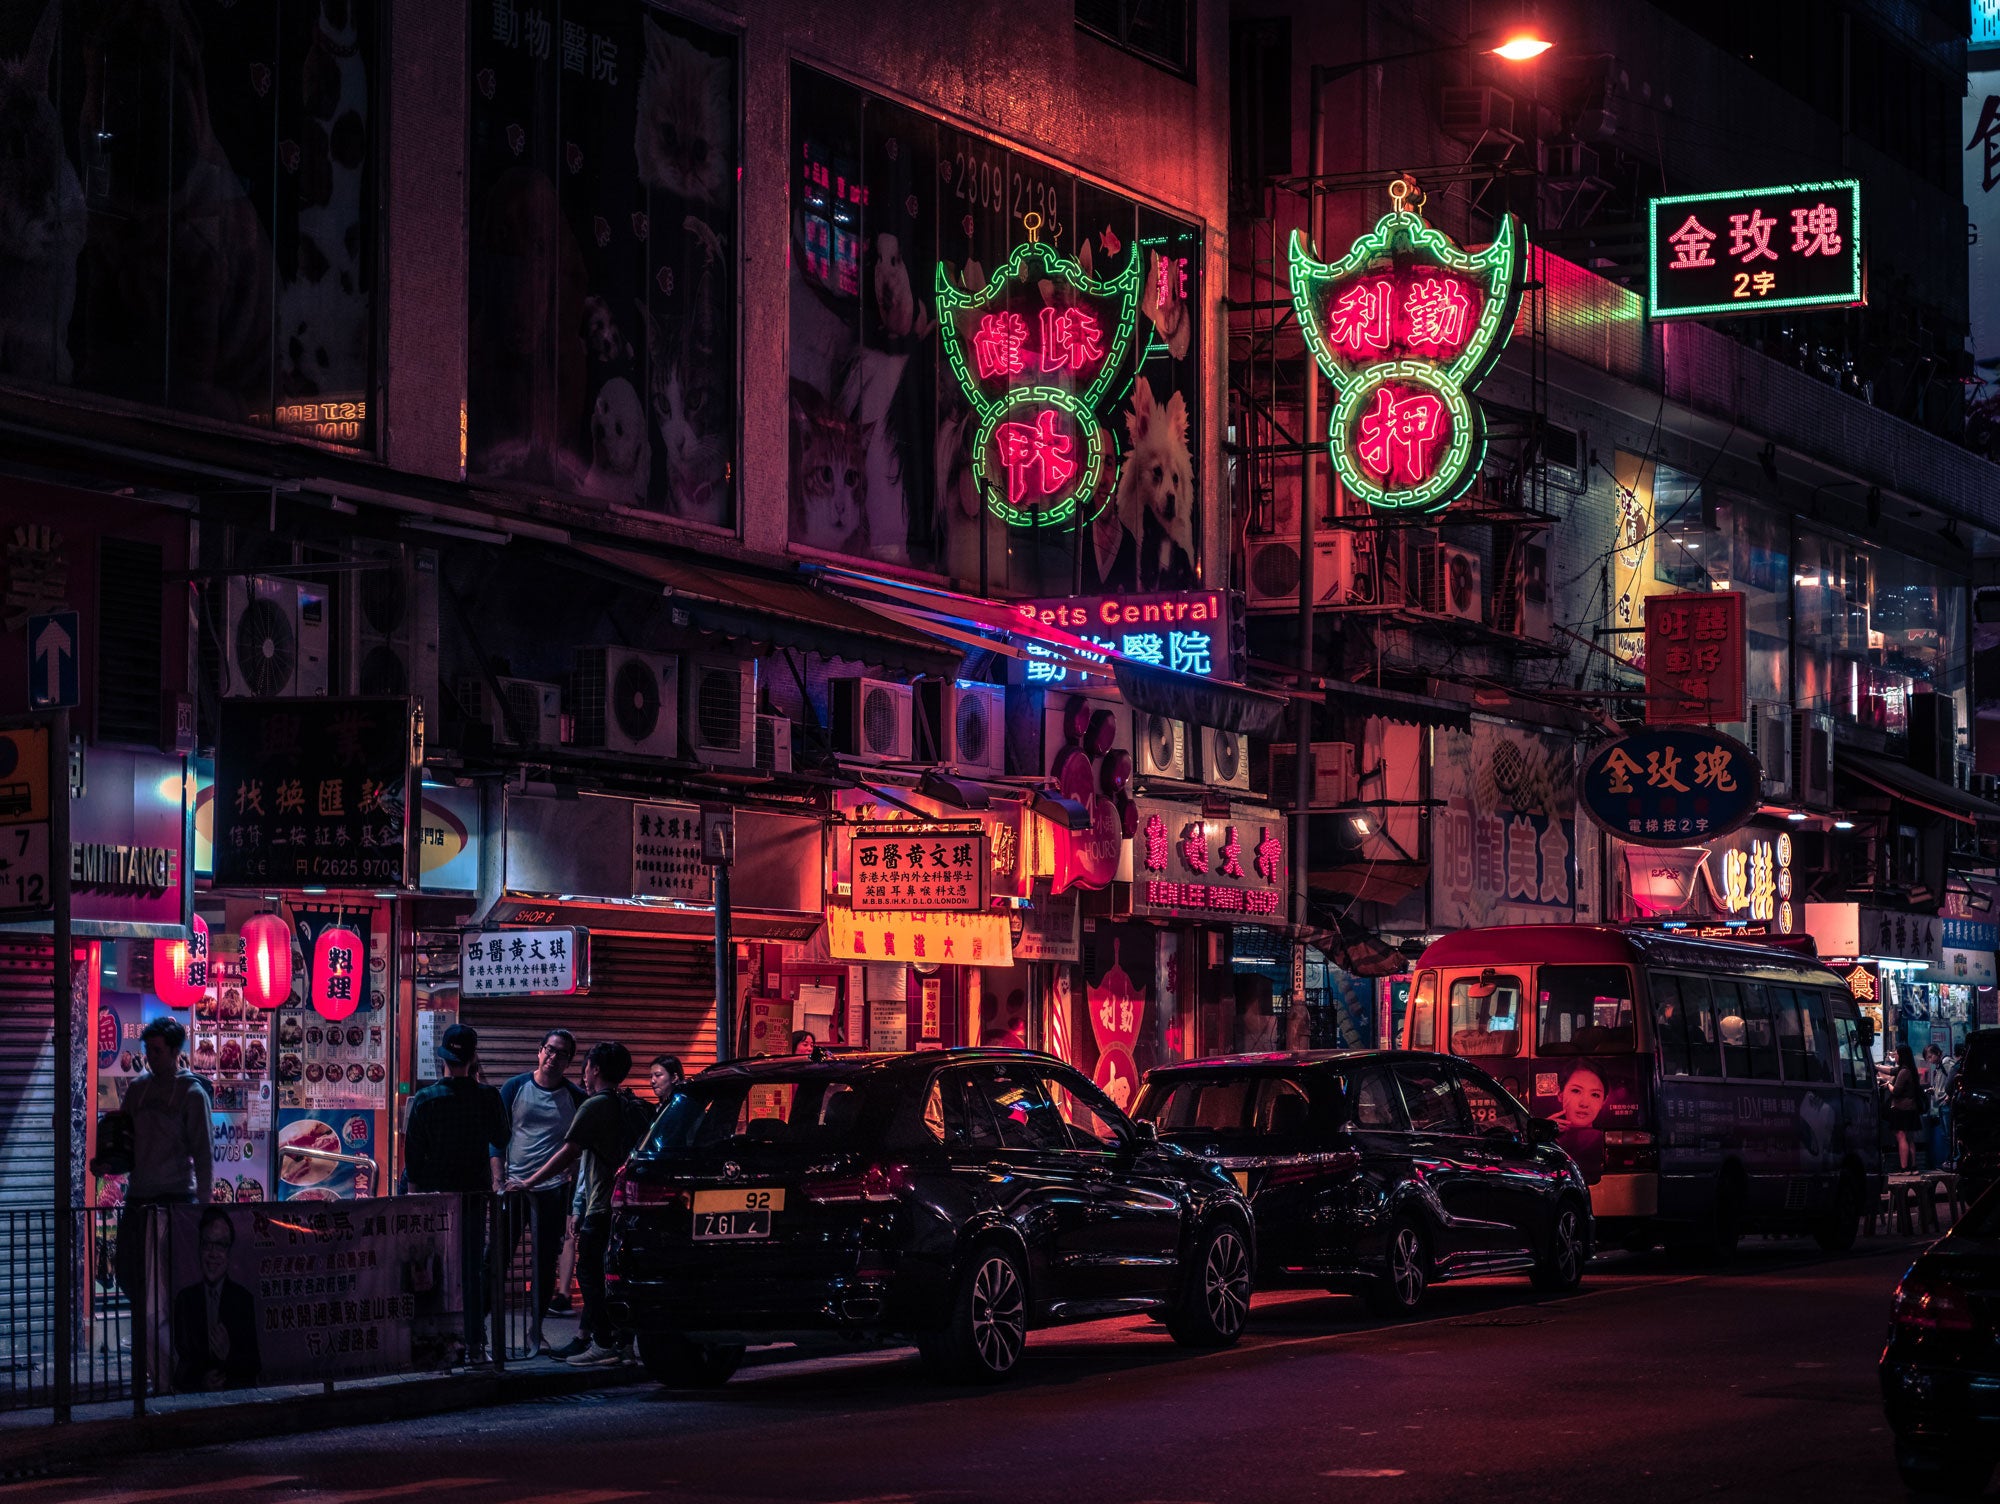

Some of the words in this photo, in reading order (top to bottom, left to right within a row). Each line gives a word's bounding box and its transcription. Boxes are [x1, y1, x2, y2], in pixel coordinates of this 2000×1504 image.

[956, 152, 1002, 212] 2309
[1013, 172, 1057, 232] 2139
[1667, 203, 1842, 269] 金玫瑰
[1733, 271, 1776, 297] 2字
[1358, 386, 1443, 480] 押
[1019, 604, 1087, 626] Pets
[1101, 596, 1218, 625] Central
[1600, 745, 1738, 794] 金玫瑰
[235, 776, 388, 818] 找換匯款
[15, 829, 30, 857] 7
[419, 827, 445, 846] 門店
[1084, 840, 1117, 861] HOURS
[70, 842, 177, 888] EMITTANCE
[320, 859, 359, 877] 2625
[859, 843, 973, 869] 西醫黃文琪
[16, 873, 43, 902] 12
[1179, 883, 1205, 907] LEE
[1245, 889, 1279, 914] SHOP
[515, 910, 545, 923] SHOP
[545, 912, 555, 923] 6
[186, 932, 207, 986] 料理
[468, 937, 567, 962] 西醫黃文琪
[327, 947, 353, 1000] 料理
[1846, 965, 1876, 1000] 食
[923, 1027, 938, 1036] 48
[746, 1192, 771, 1209] 92
